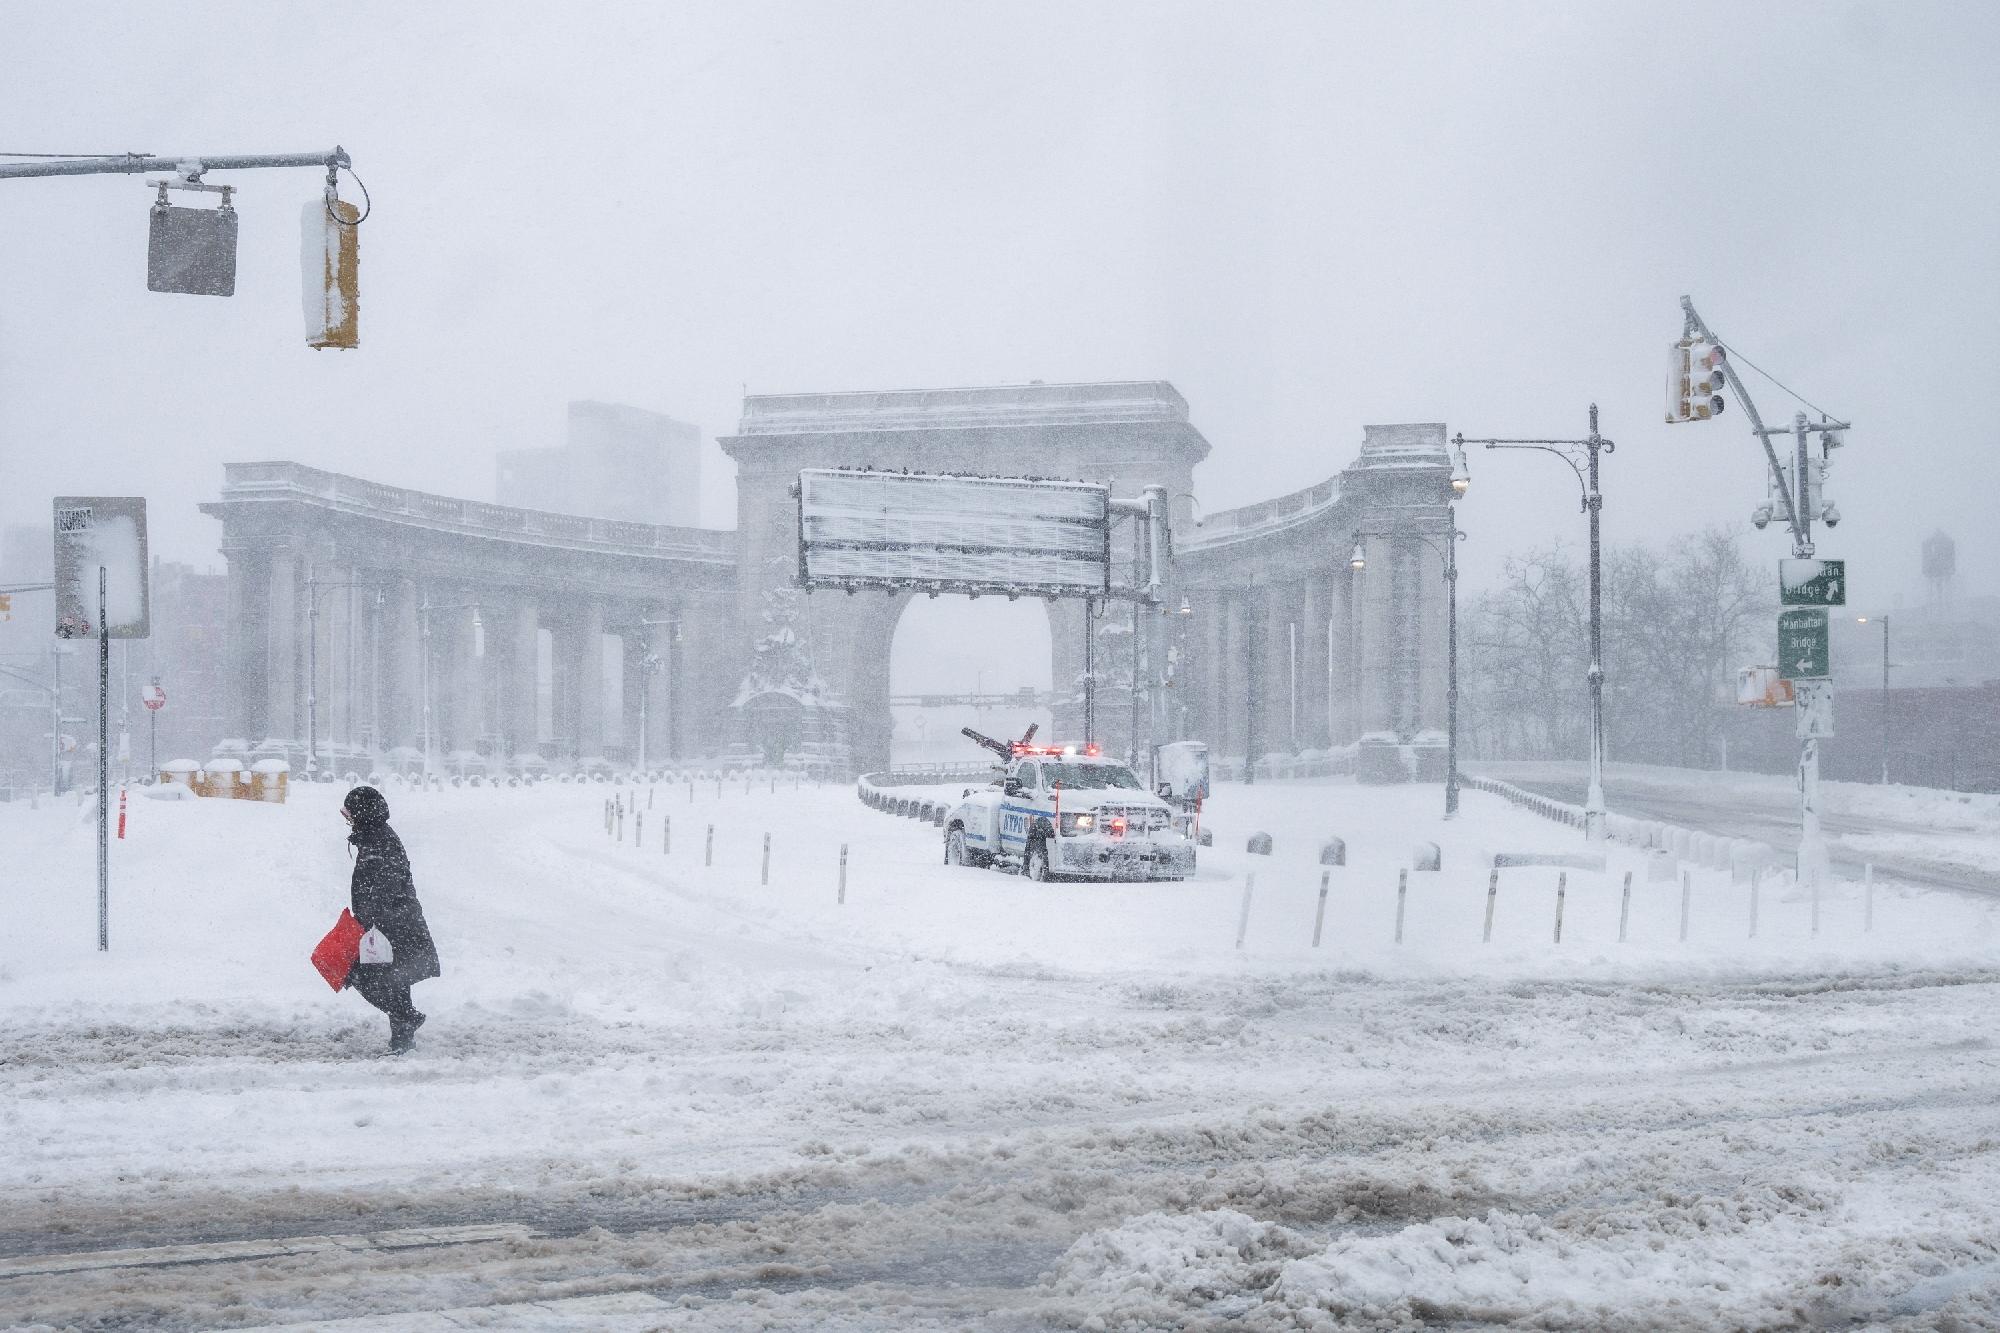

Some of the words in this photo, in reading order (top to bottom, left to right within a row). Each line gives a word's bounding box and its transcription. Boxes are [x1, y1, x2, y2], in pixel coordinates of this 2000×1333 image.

[1783, 617, 1823, 630] Manhattan
[1791, 636, 1817, 651] Bridge
[1003, 813, 1024, 833] NYPD
